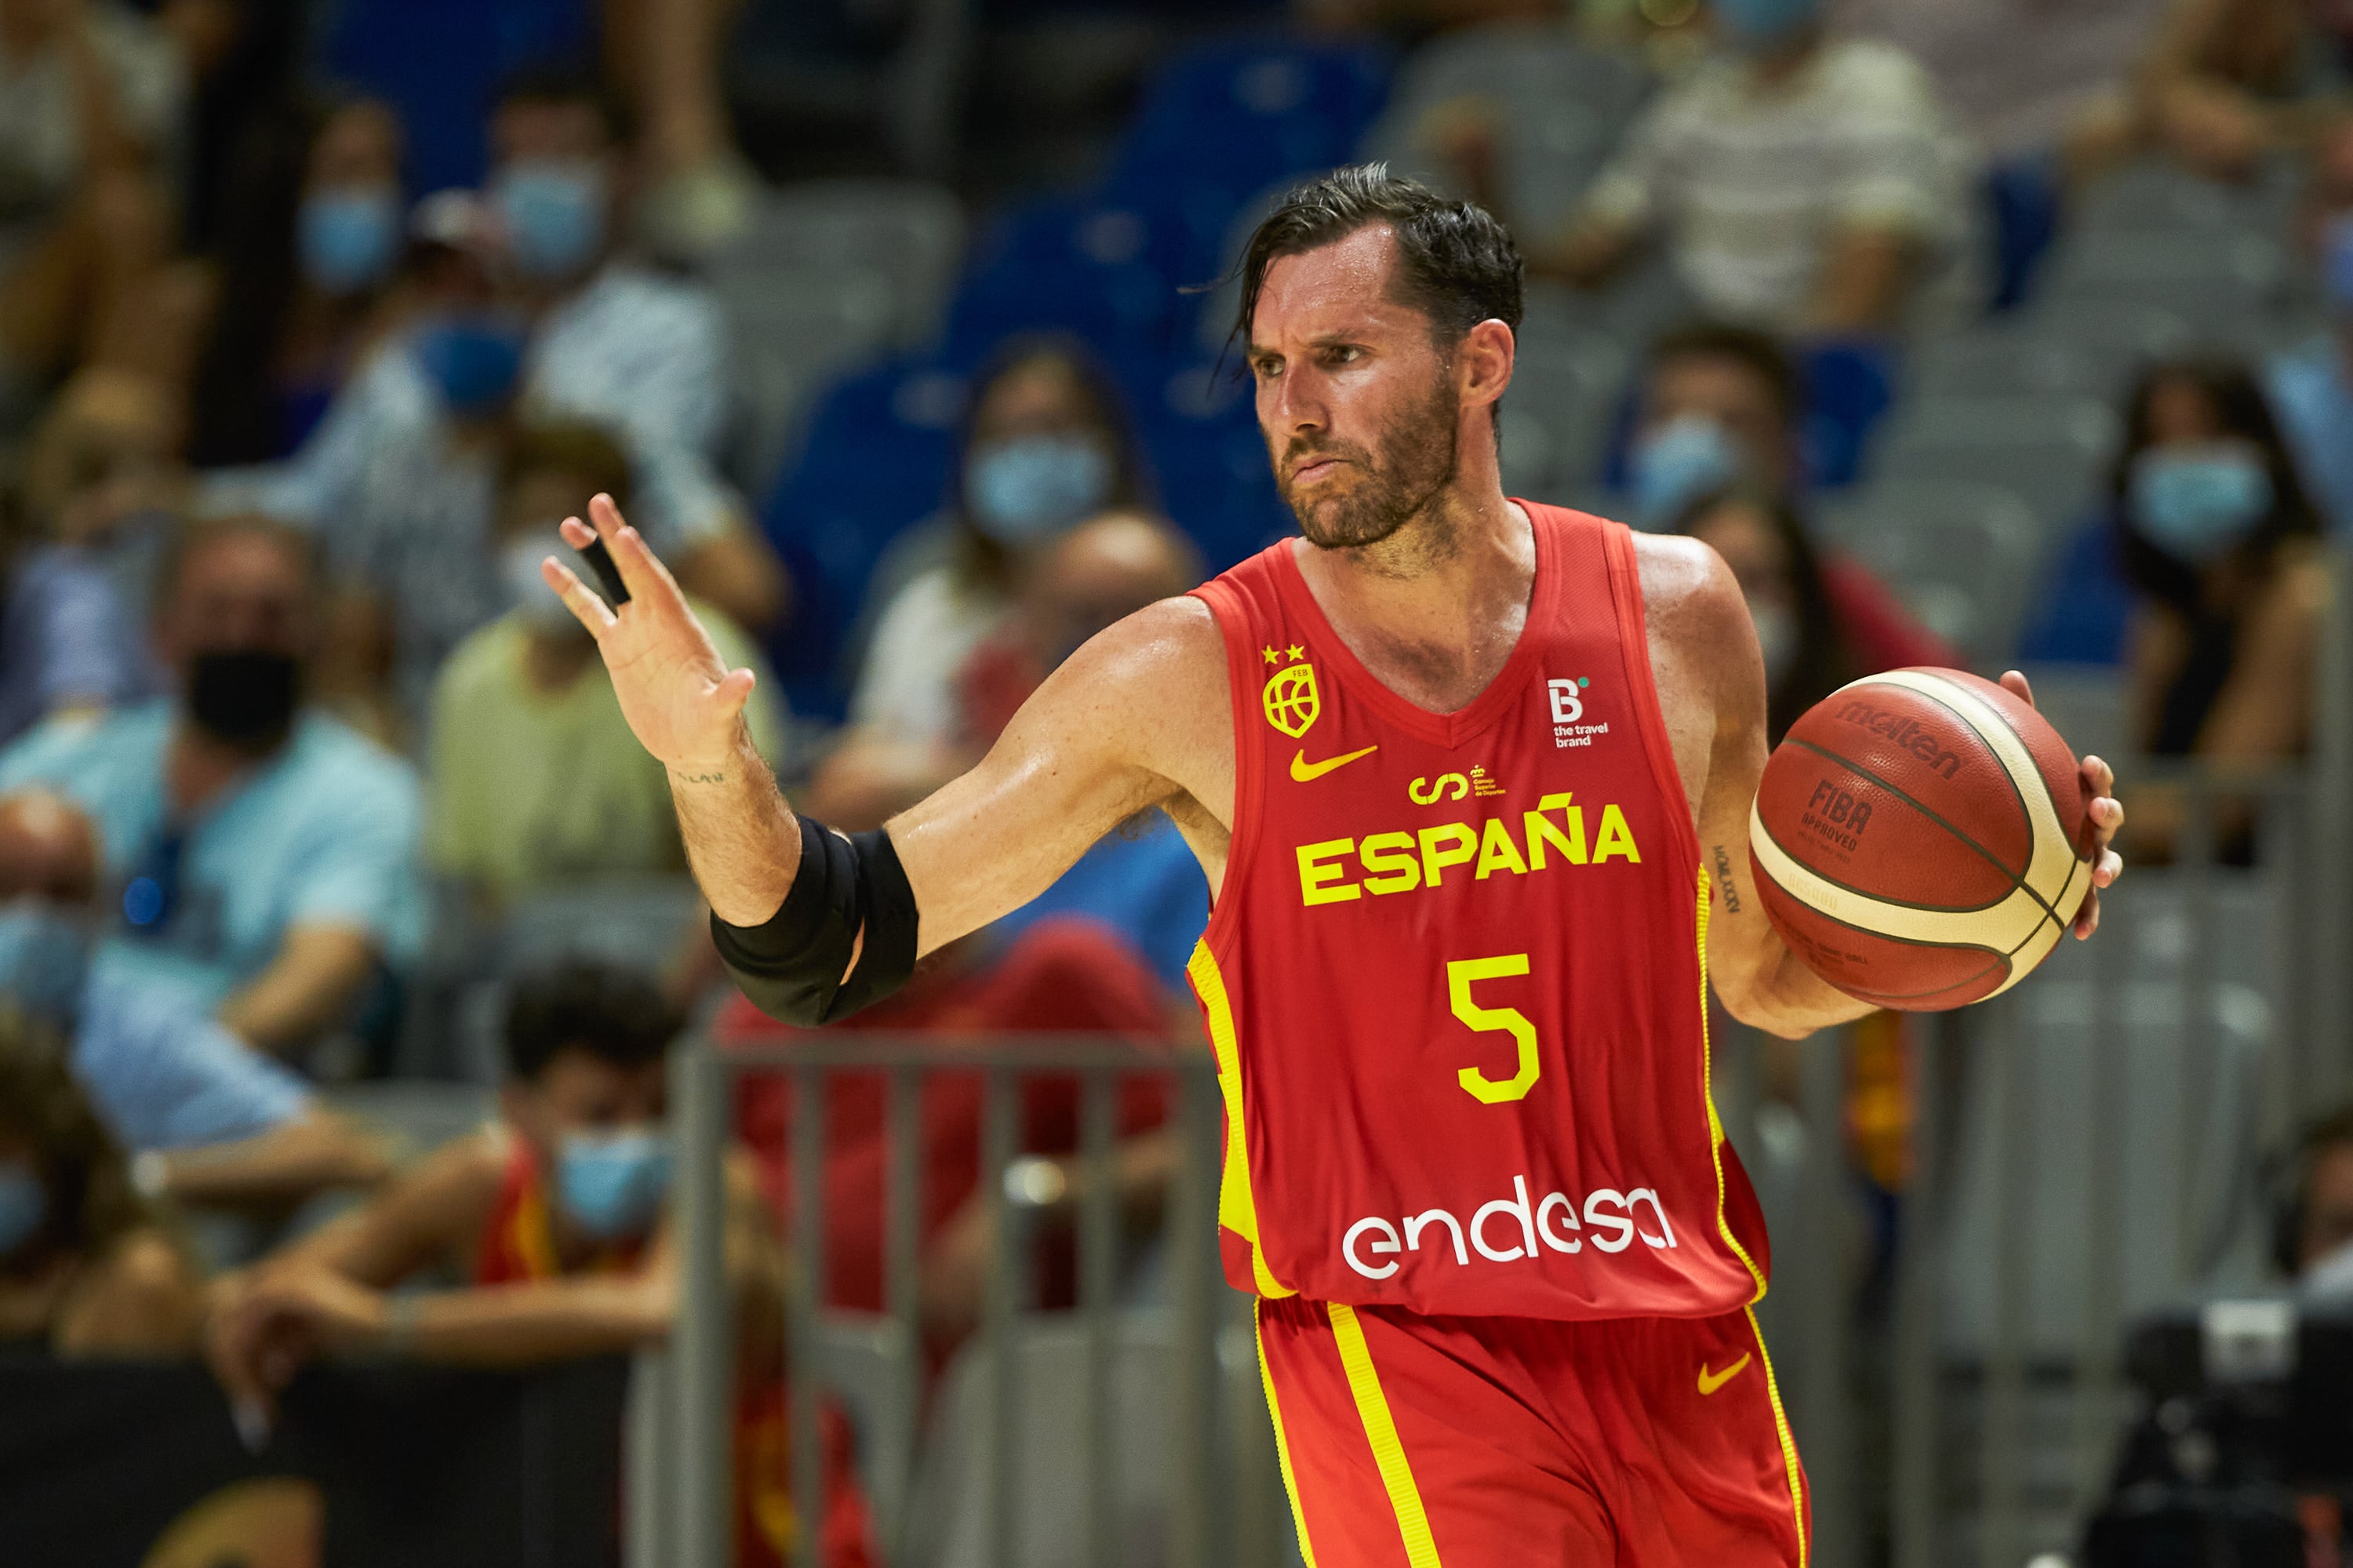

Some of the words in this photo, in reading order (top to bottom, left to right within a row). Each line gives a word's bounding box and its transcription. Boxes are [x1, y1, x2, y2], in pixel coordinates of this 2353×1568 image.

[1554, 726, 1573, 737] the
[1574, 722, 1609, 735] travel
[1555, 734, 1591, 748] brand
[1835, 701, 1960, 780] molten
[1801, 812, 1857, 852] APPROVED
[1809, 779, 1872, 835] FIBA
[1296, 791, 1642, 907] ESPAÑA
[1447, 953, 1540, 1104] 5
[1342, 1174, 1677, 1279] endesa
